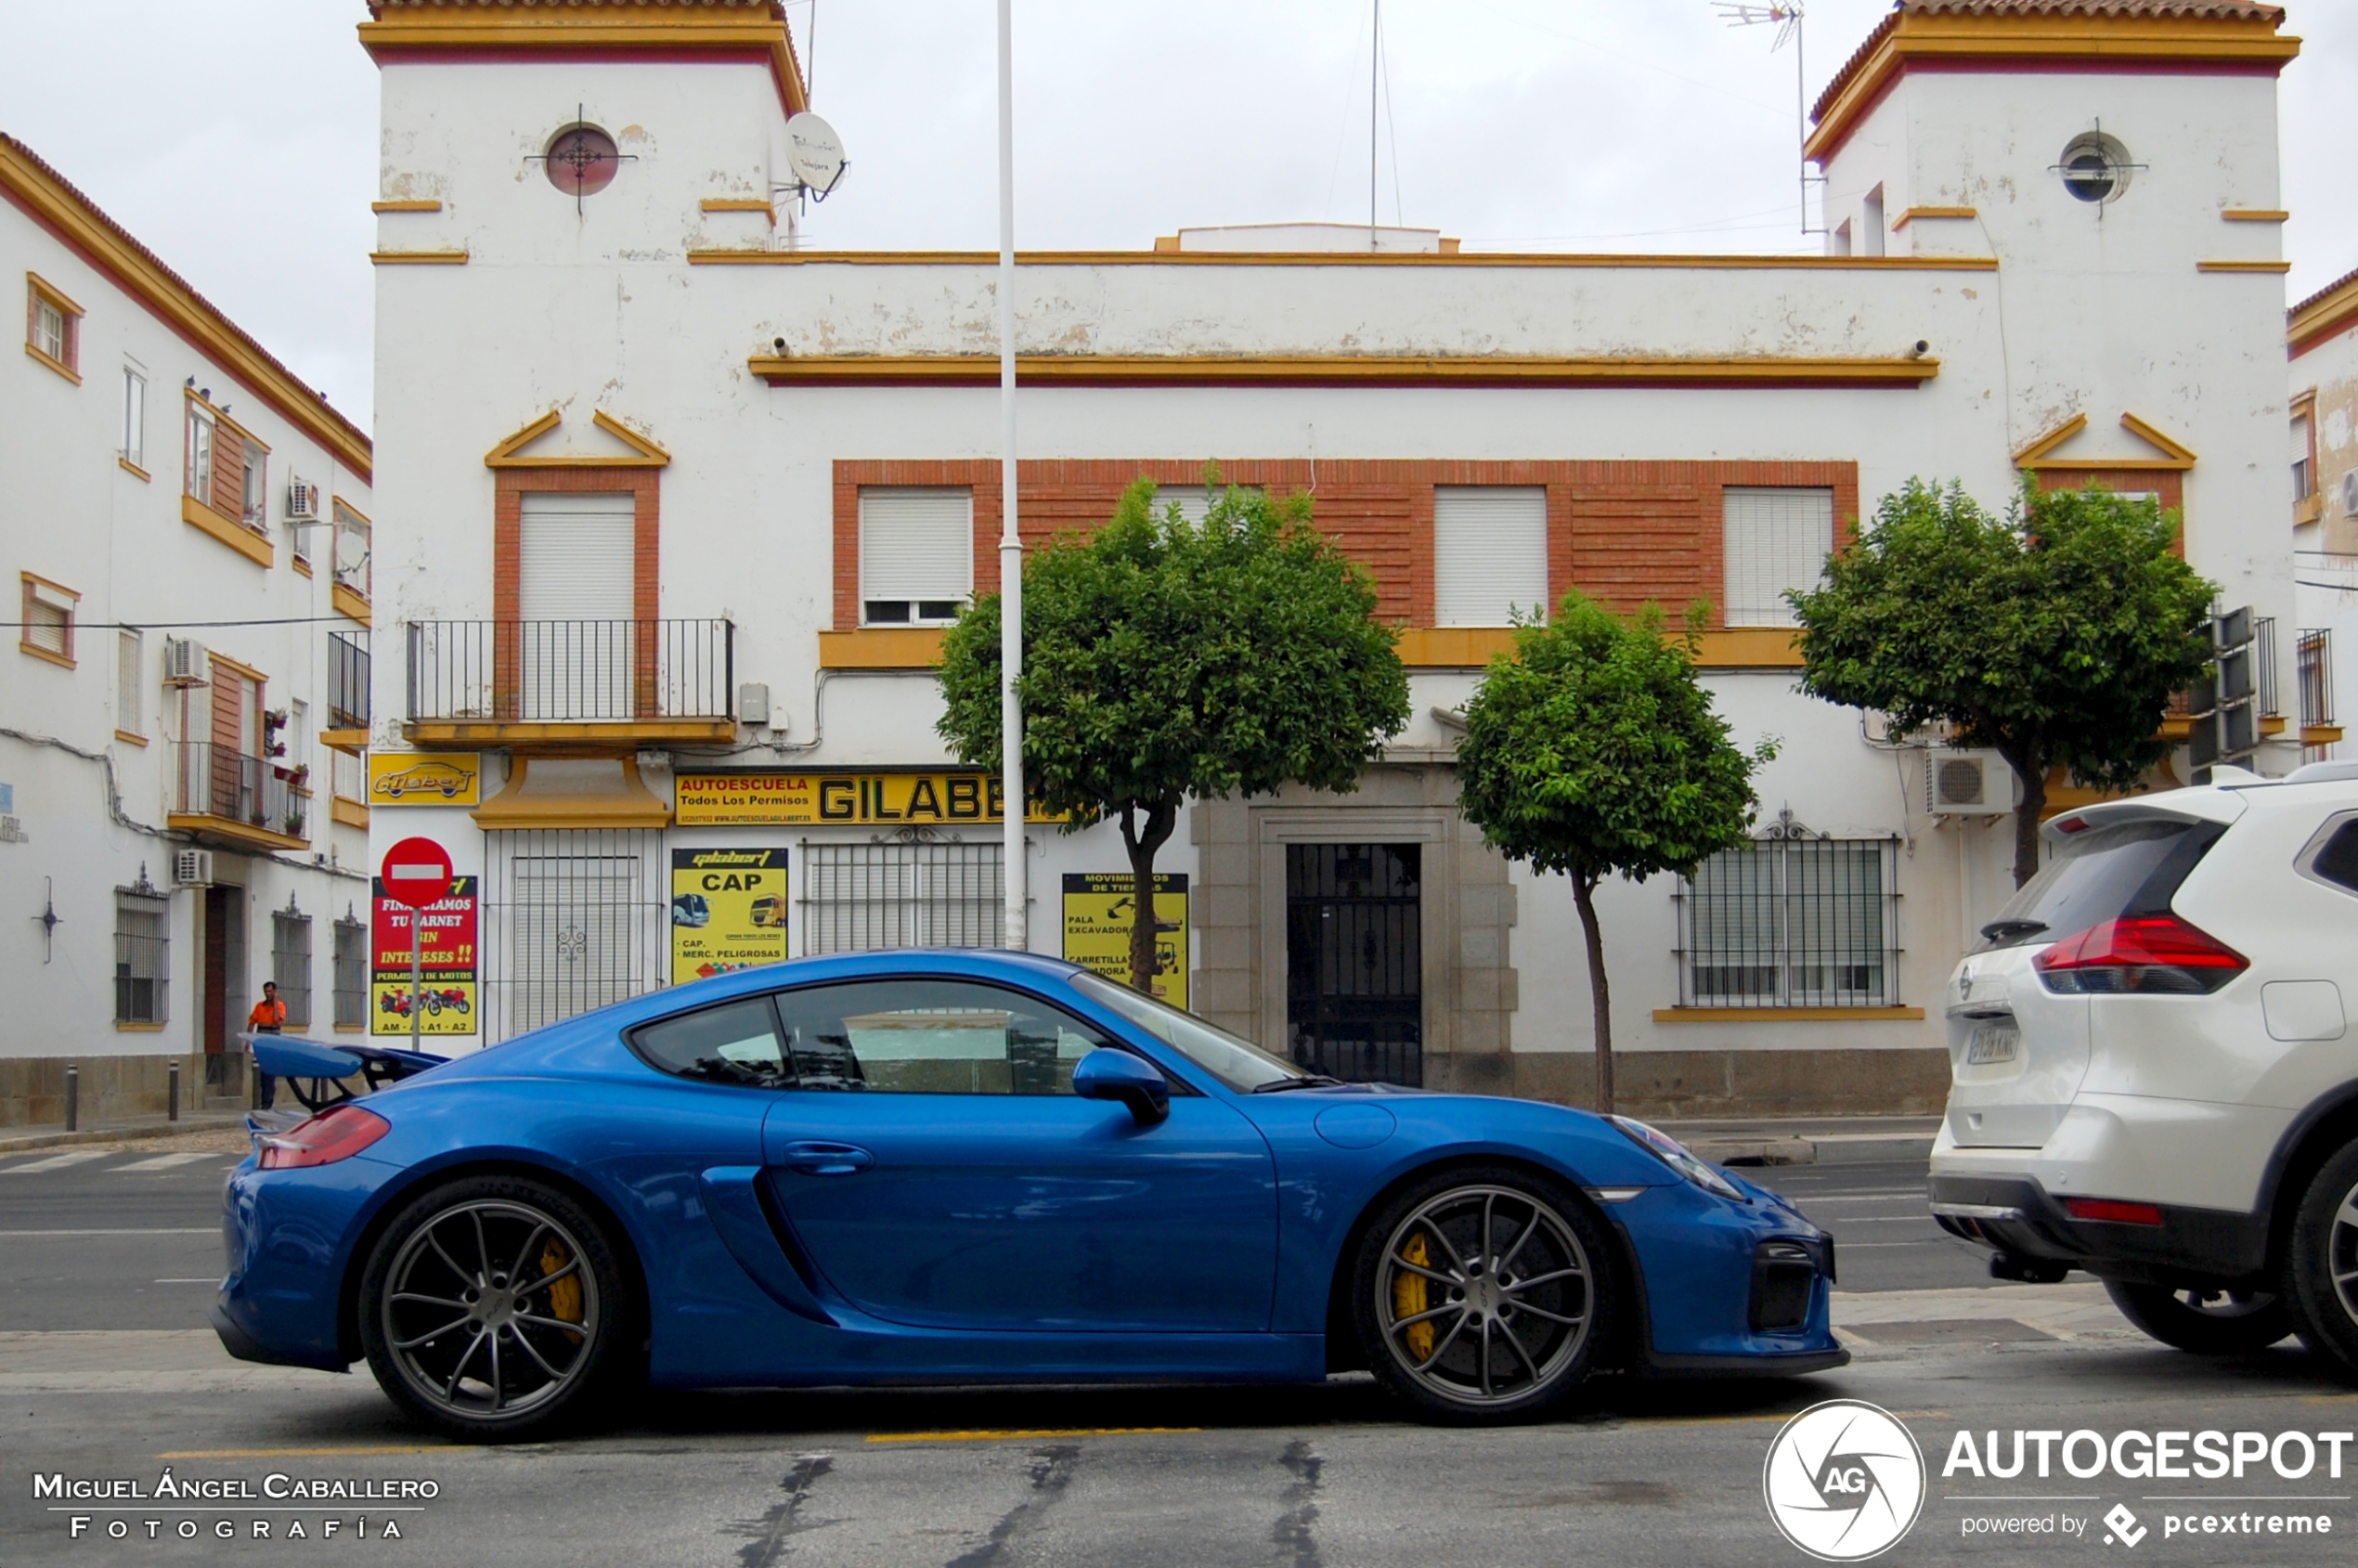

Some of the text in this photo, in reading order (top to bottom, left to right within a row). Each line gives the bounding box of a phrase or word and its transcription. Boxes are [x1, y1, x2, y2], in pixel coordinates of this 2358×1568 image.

[680, 779, 809, 791] AUTOESCUELA
[680, 796, 809, 805] Todos Los Permisos
[702, 874, 762, 891] CAP
[391, 915, 408, 927] TU
[381, 951, 454, 964] INTEESES
[718, 950, 781, 958] PELIGROSAS
[377, 972, 423, 980] PERMISS
[439, 971, 473, 979] MOTOS
[382, 1023, 400, 1031] AM
